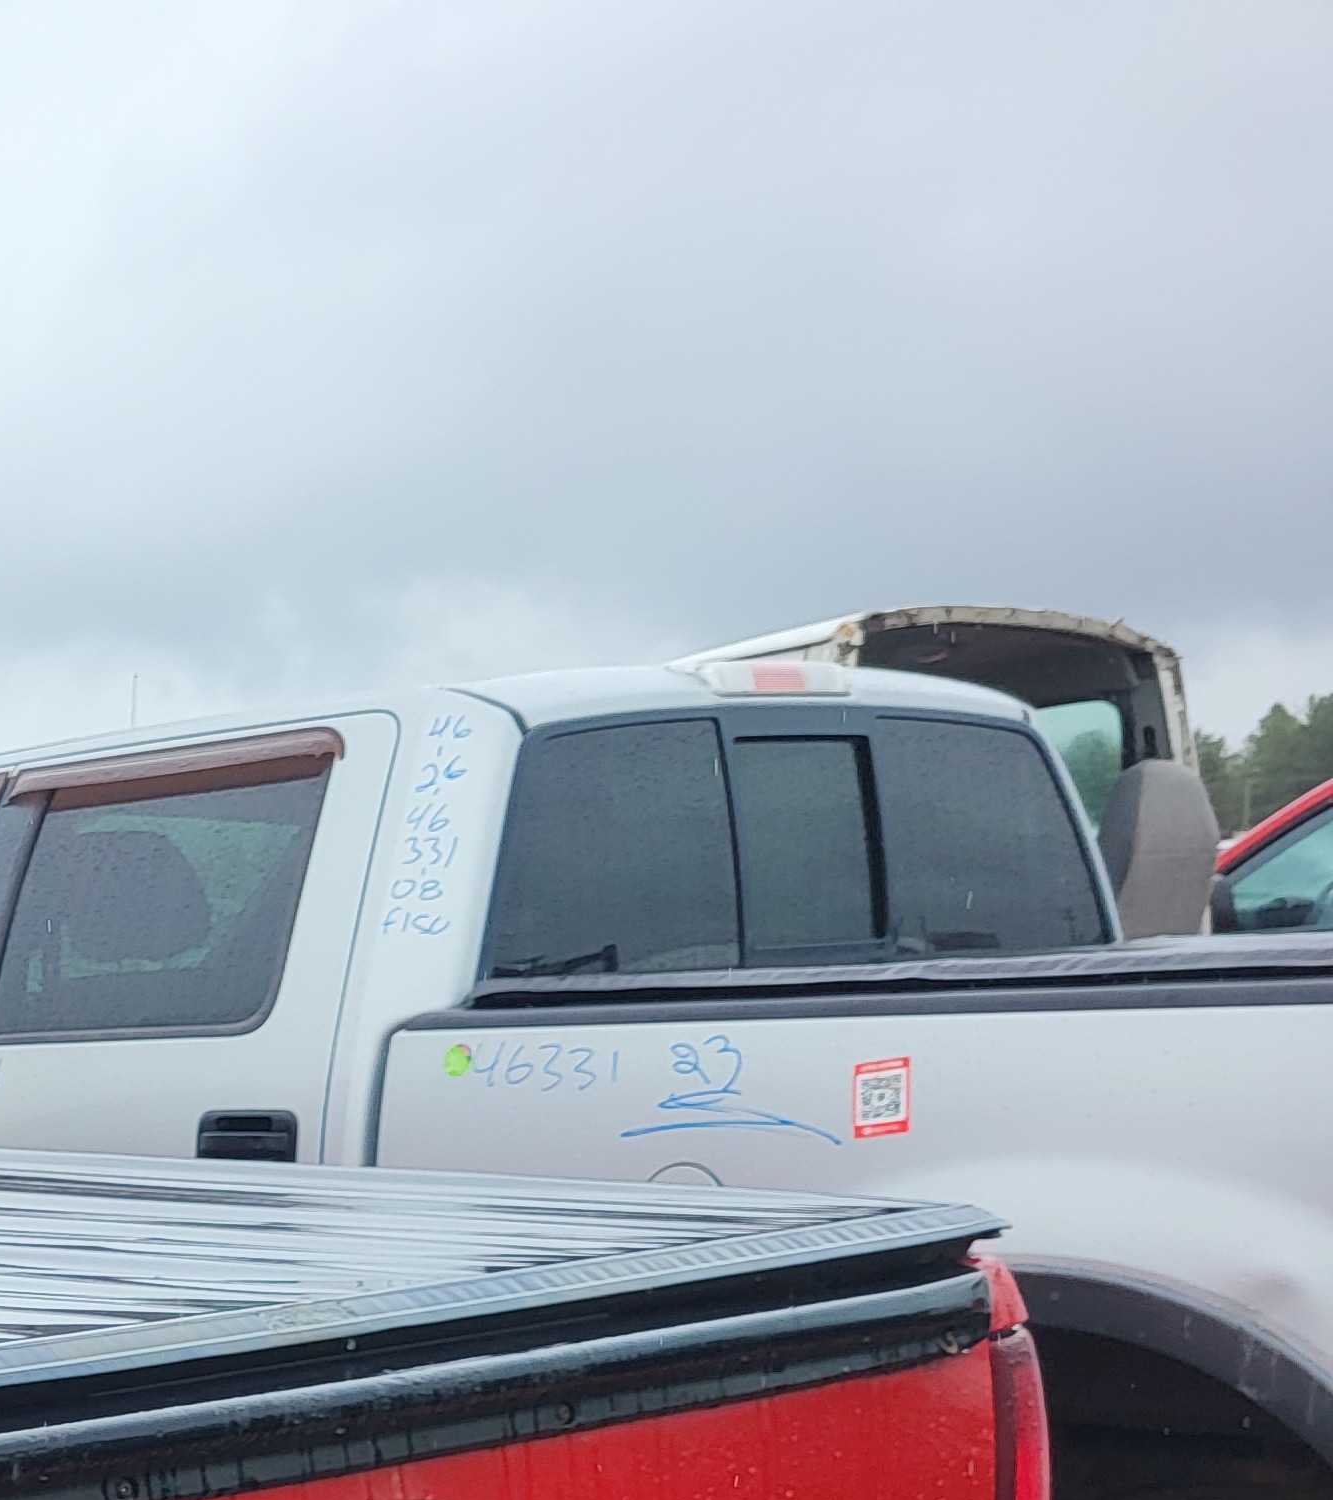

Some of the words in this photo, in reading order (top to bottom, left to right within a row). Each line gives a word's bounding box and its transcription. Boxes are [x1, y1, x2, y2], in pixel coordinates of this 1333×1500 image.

[415, 755, 467, 793] 26
[406, 803, 450, 832] 46
[401, 836, 459, 868] 331
[473, 1041, 619, 1093] 46331
